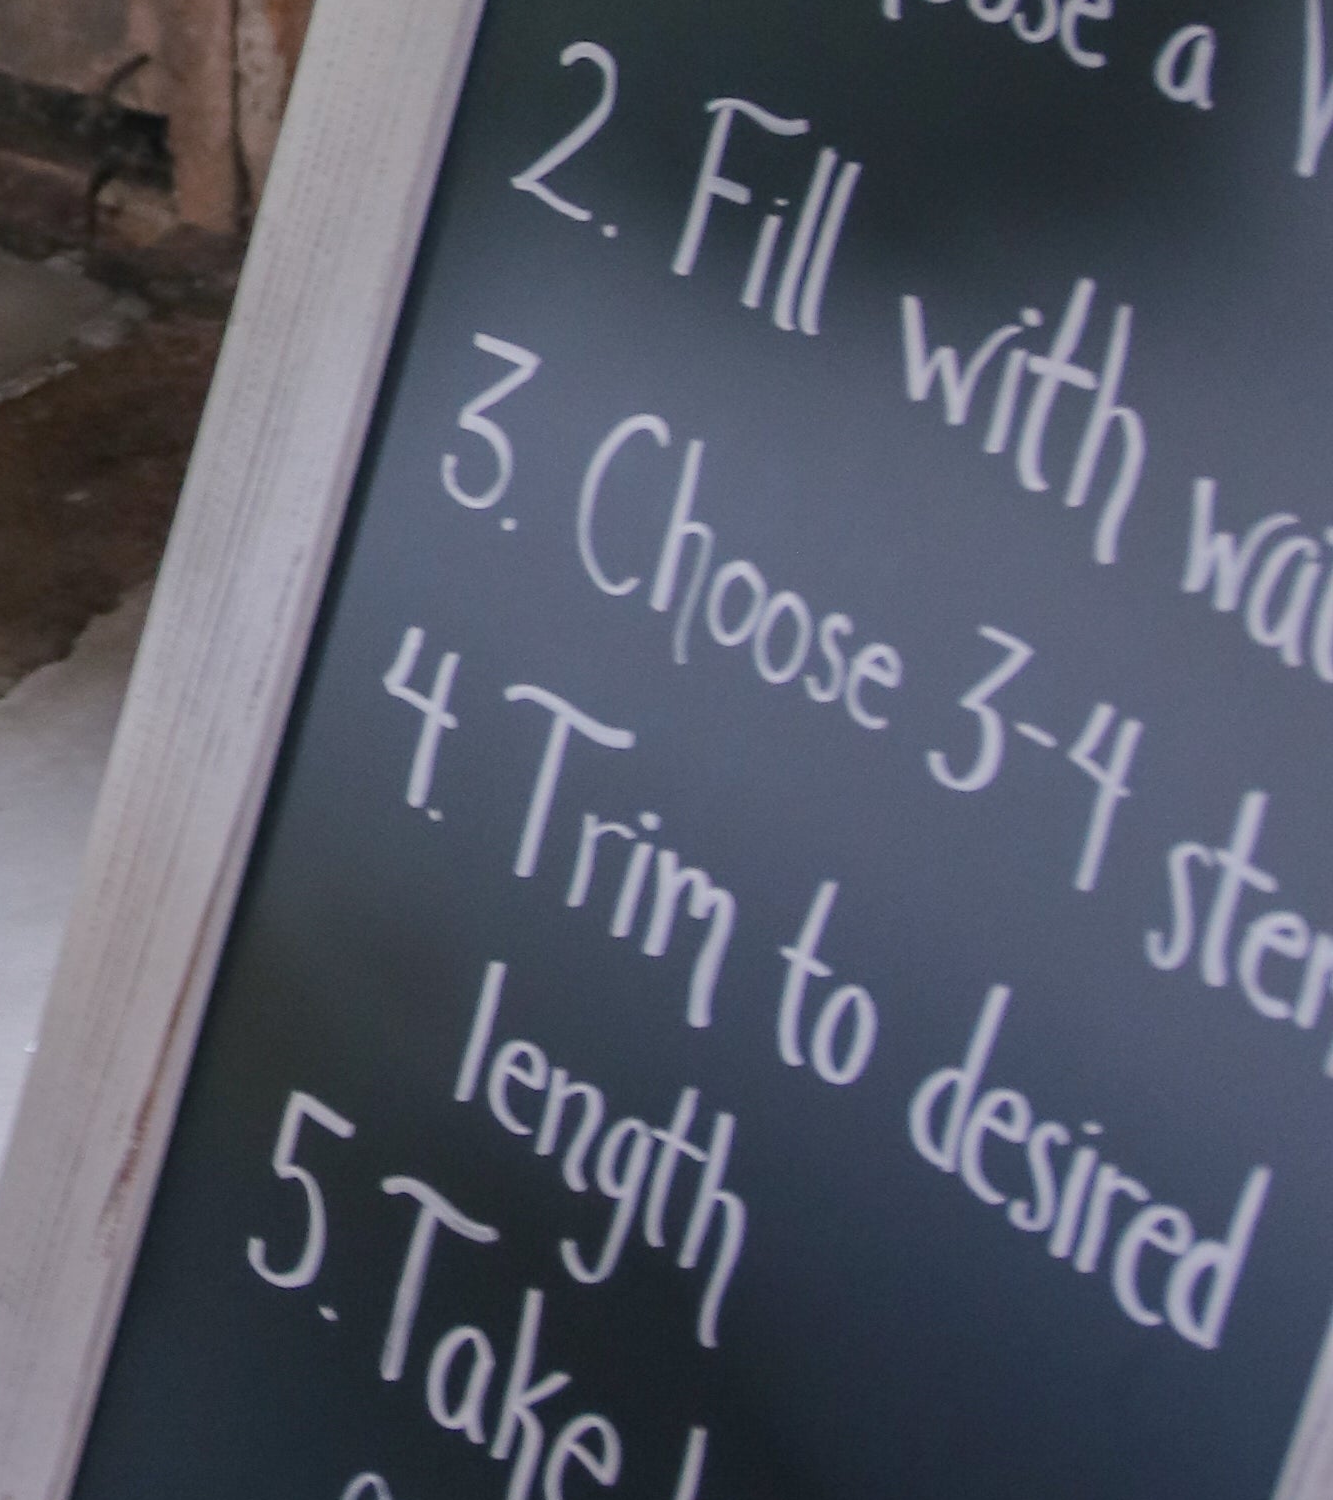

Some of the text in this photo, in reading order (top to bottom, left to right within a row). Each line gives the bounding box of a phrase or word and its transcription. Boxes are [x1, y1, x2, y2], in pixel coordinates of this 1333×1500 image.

[1152, 23, 1217, 111] a
[510, 40, 619, 240] 2.
[672, 96, 863, 336] Fill
[901, 276, 1146, 566] with
[441, 332, 541, 532] 3.
[577, 412, 902, 731] Choose
[926, 625, 1142, 892] 3-4
[245, 1089, 357, 1322] 5.
[381, 624, 1271, 1351] 4. Trim to desired
[453, 959, 747, 1349] length
